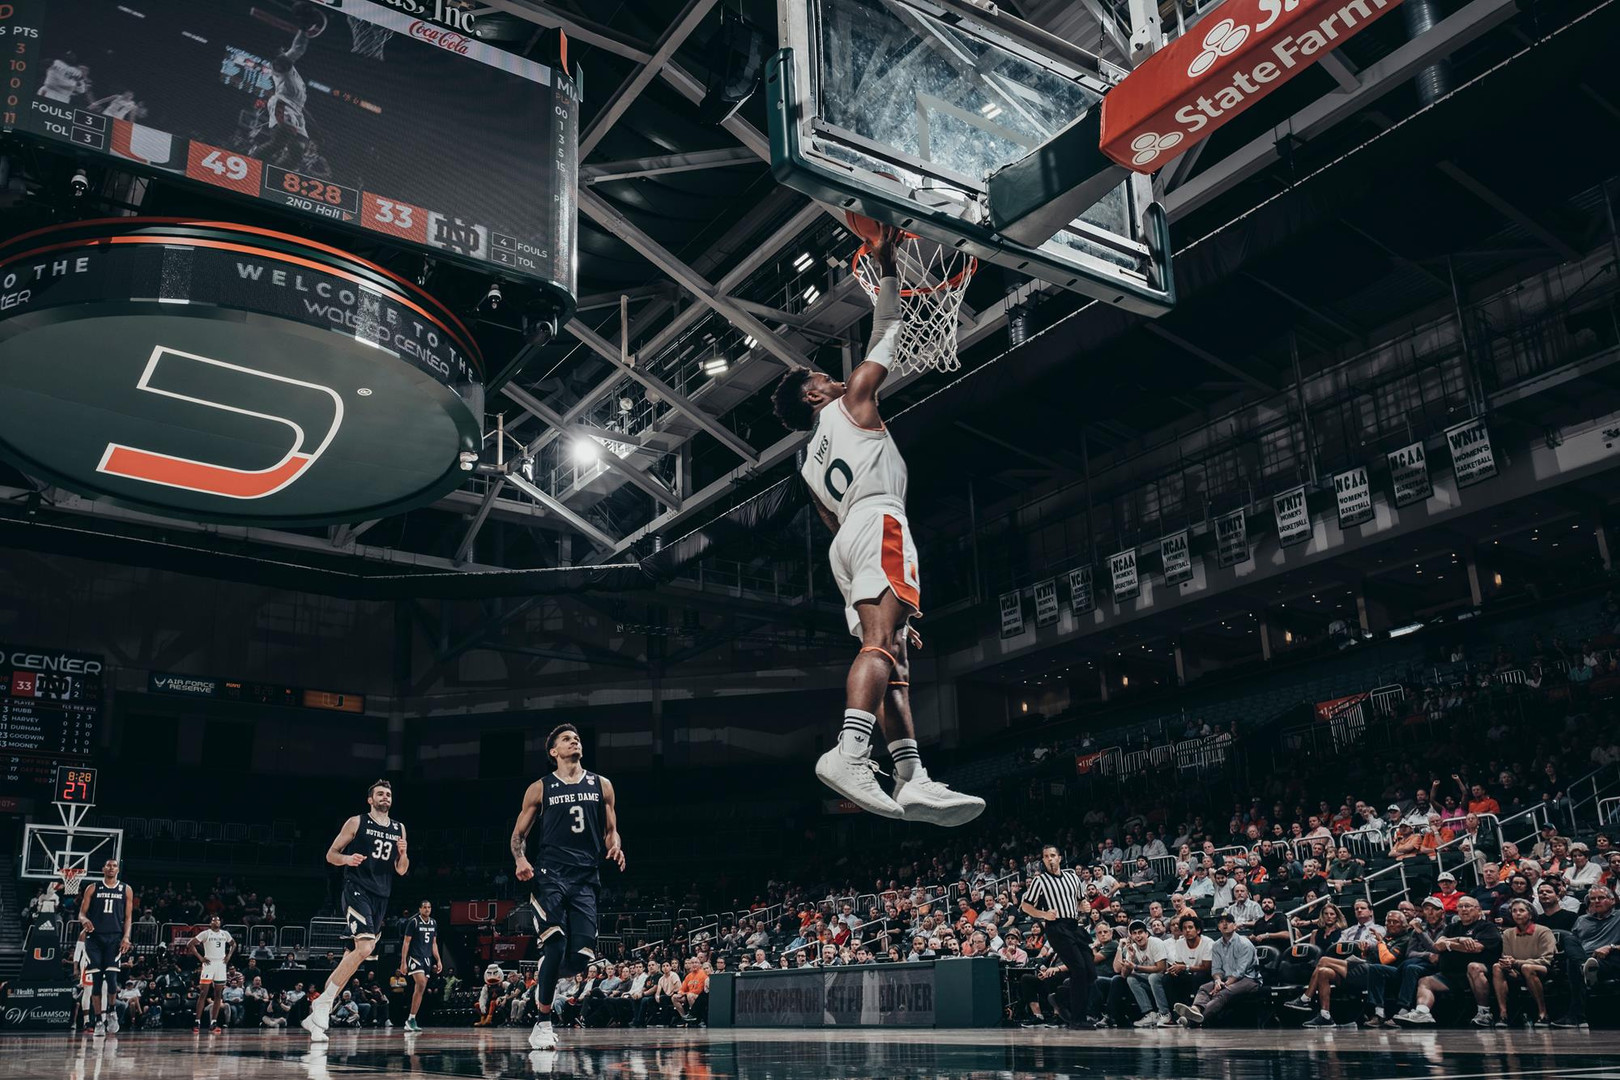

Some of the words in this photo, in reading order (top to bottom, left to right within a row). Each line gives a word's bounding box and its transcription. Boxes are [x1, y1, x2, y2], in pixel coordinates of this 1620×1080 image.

[427, 0, 481, 36] Inc.
[13, 26, 39, 38] PTS
[16, 43, 26, 54] 3
[10, 60, 26, 71] 10
[10, 77, 21, 89] 0
[7, 95, 18, 106] 0
[3, 112, 16, 124] 11
[32, 101, 73, 121] FOULS
[85, 116, 93, 126] 3
[44, 121, 69, 136] TOL
[84, 133, 92, 143] 3
[201, 151, 248, 180] 49
[283, 173, 341, 205] 8:28
[285, 196, 312, 211] 2ND
[315, 205, 340, 219] Half
[375, 199, 413, 229] 33
[500, 238, 507, 246] 4
[517, 242, 548, 258] FOULS
[33, 257, 89, 280] THE
[500, 254, 507, 262] 2
[517, 256, 536, 269] TOL
[236, 262, 398, 326] WELCOME
[413, 321, 438, 348] TO
[448, 347, 473, 384] THE
[1449, 423, 1486, 450] WNIT
[813, 435, 829, 466] LYKES
[1390, 447, 1424, 470] NCAA
[1454, 444, 1490, 463] WOMEN'S
[1457, 455, 1492, 474] BASKETBALL
[824, 458, 854, 503] 0
[1335, 470, 1367, 493] NCAA
[1276, 492, 1303, 514] WNIT
[1340, 490, 1369, 504] WOMEN'S
[1341, 500, 1370, 515] BASKETBALL
[1217, 514, 1242, 536] WNIT
[1163, 536, 1187, 556] NCAA
[1113, 555, 1135, 573] NCAA
[16, 681, 32, 691] 33
[166, 678, 184, 686] AIR
[184, 680, 216, 690] FORCE
[169, 683, 213, 694] RESERVE
[73, 690, 80, 698] 2
[2, 714, 8, 722] 5
[9, 732, 45, 741] GOODWIN
[10, 724, 41, 732] DURHAM
[8, 741, 39, 749] MOONEY
[68, 771, 92, 783] 8:28
[63, 781, 88, 800] 27
[548, 793, 576, 807] NOTRE
[577, 792, 600, 802] DAME
[569, 805, 586, 834] 3
[366, 828, 385, 839] NOTRE
[371, 839, 393, 862] 33
[103, 899, 114, 914] 11
[424, 932, 430, 944] 5
[897, 982, 933, 1011] OVER
